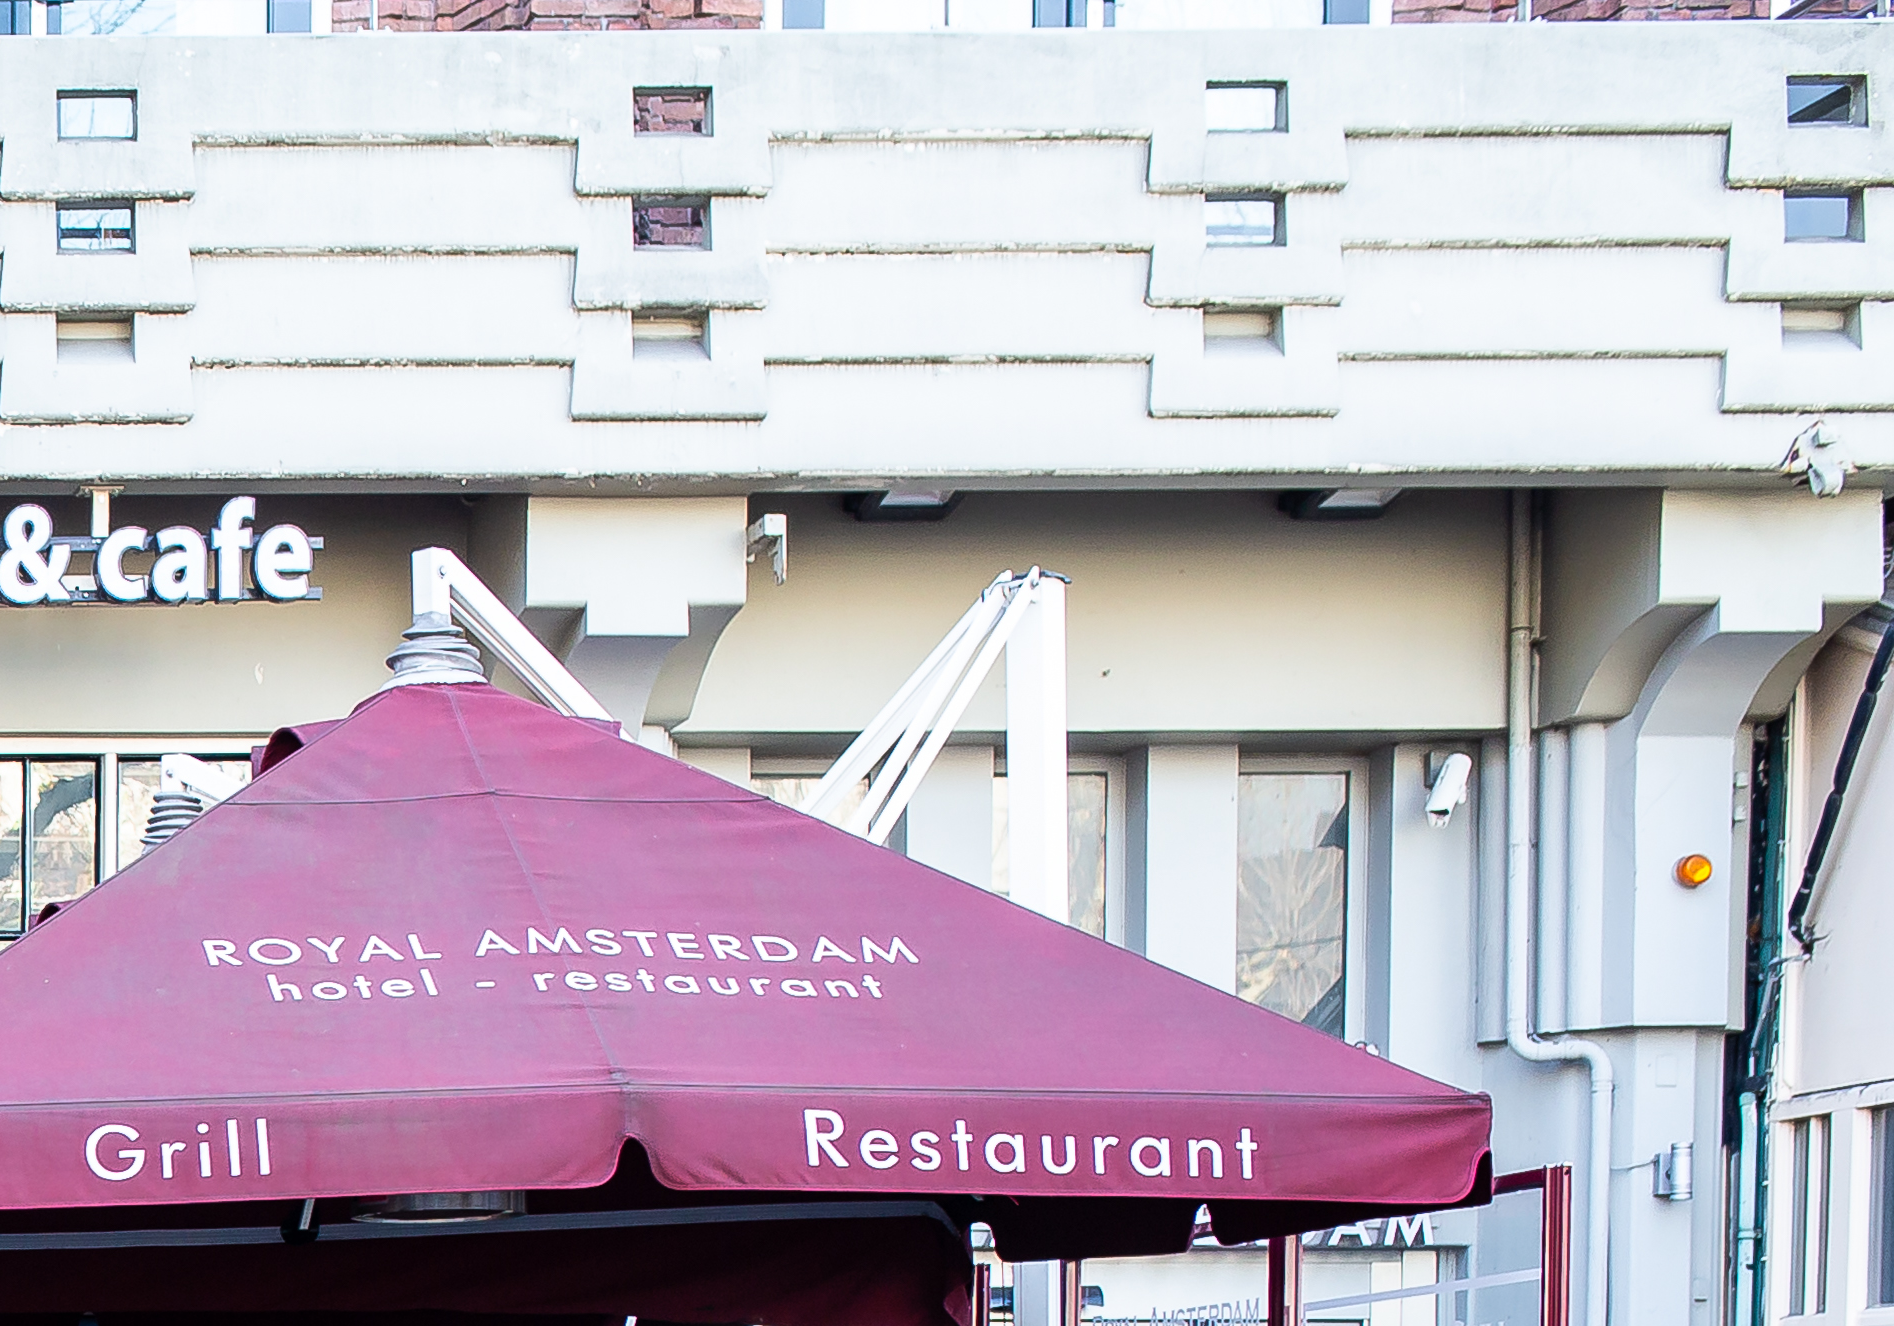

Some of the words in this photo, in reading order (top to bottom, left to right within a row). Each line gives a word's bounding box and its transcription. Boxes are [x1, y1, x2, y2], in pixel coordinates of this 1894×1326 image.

[93, 495, 316, 606] cafe
[201, 932, 443, 967] ROYAL
[474, 926, 920, 965] AMSTERDAM
[265, 967, 440, 1003] hotel
[532, 967, 884, 1000] restaurant
[84, 1117, 271, 1182] Grill
[802, 1108, 1259, 1180] Restaurant
